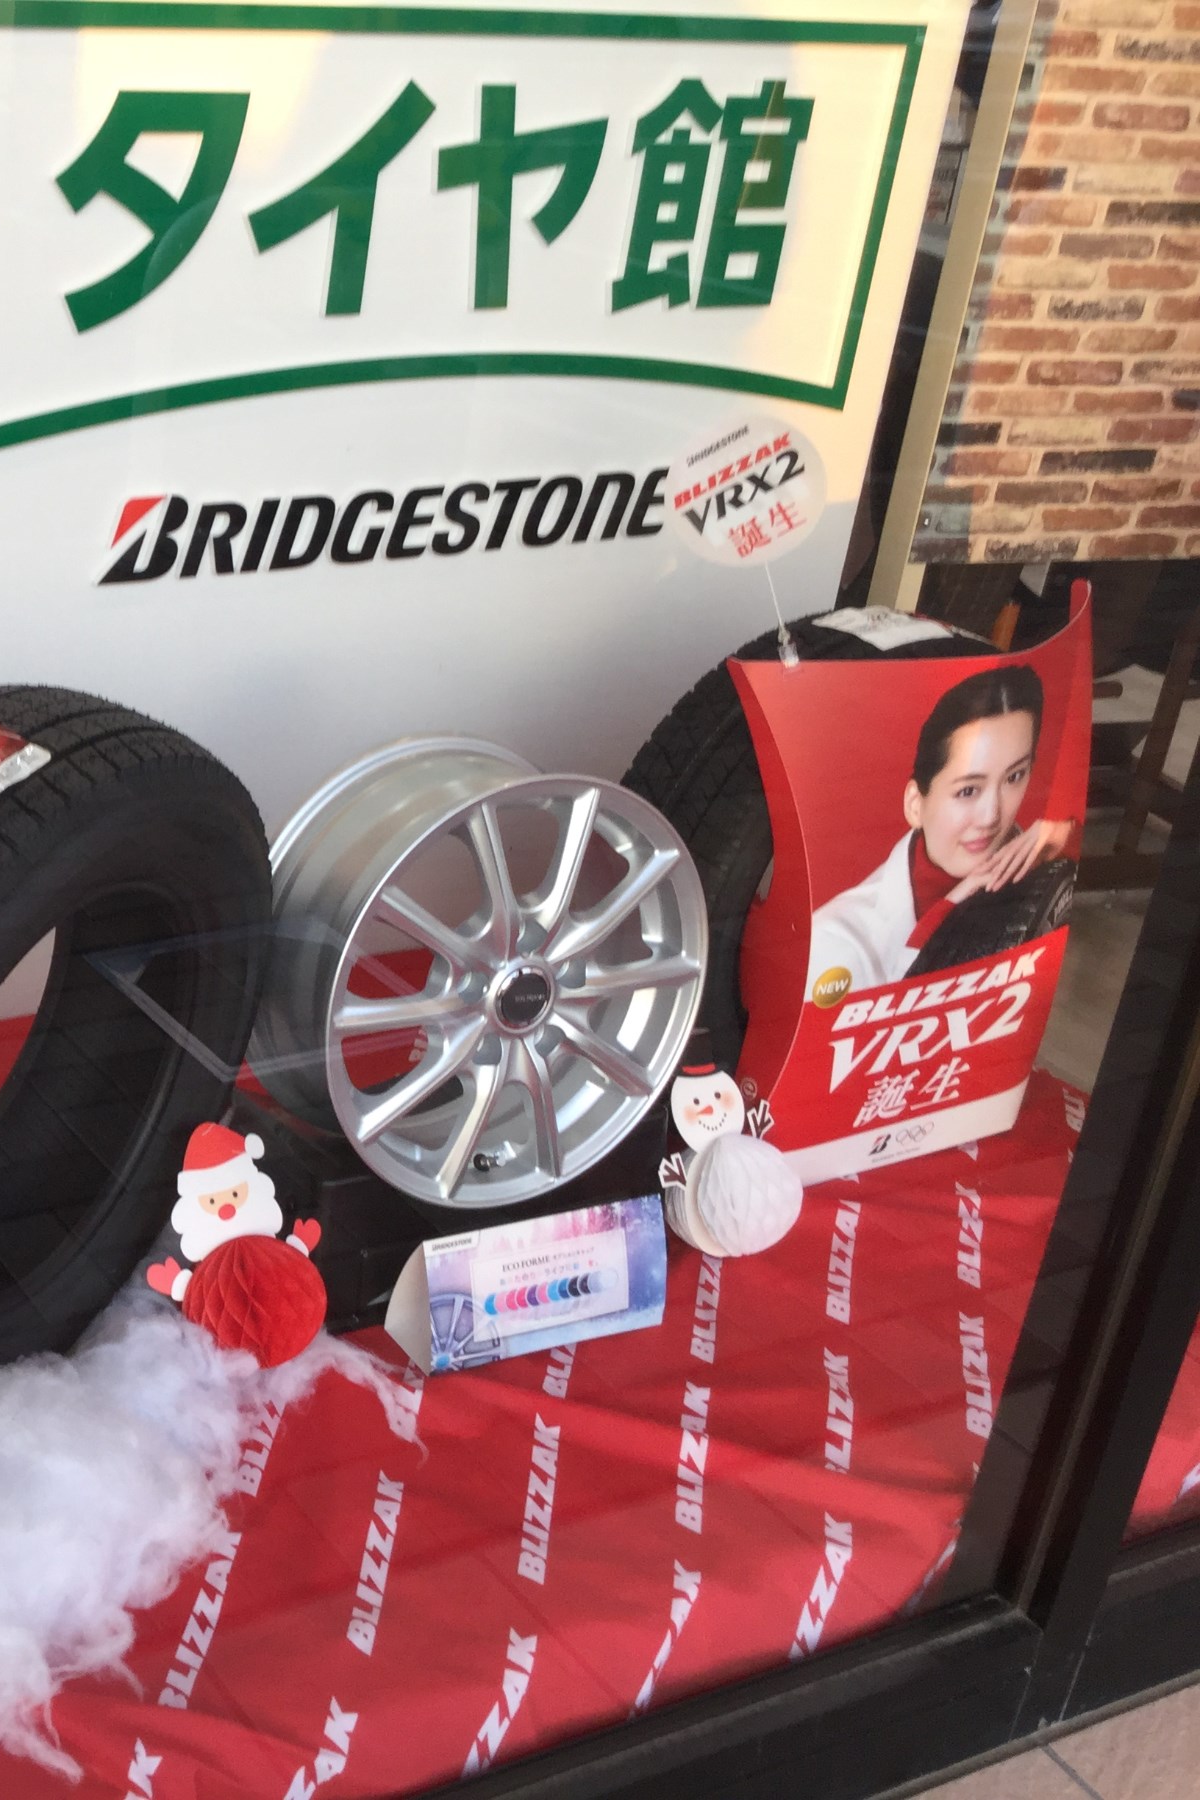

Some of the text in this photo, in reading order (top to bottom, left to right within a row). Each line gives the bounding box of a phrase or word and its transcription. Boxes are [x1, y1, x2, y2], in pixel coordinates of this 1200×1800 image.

[54, 78, 815, 334] タイヤ館
[674, 432, 791, 509] BLIZZAK
[682, 449, 806, 536] VRX2
[96, 465, 670, 585] BRIDGESTONE
[726, 500, 808, 559] 誕生
[816, 978, 850, 997] NEW
[831, 946, 1047, 1032] BLIZZAK
[828, 981, 1032, 1095] VRX2
[852, 1057, 971, 1129] 誕生
[502, 1259, 521, 1273] ECO
[521, 1255, 551, 1269] FORME
[517, 1411, 561, 1586] BLIZZAK
[346, 1469, 405, 1657] BLIZZAK
